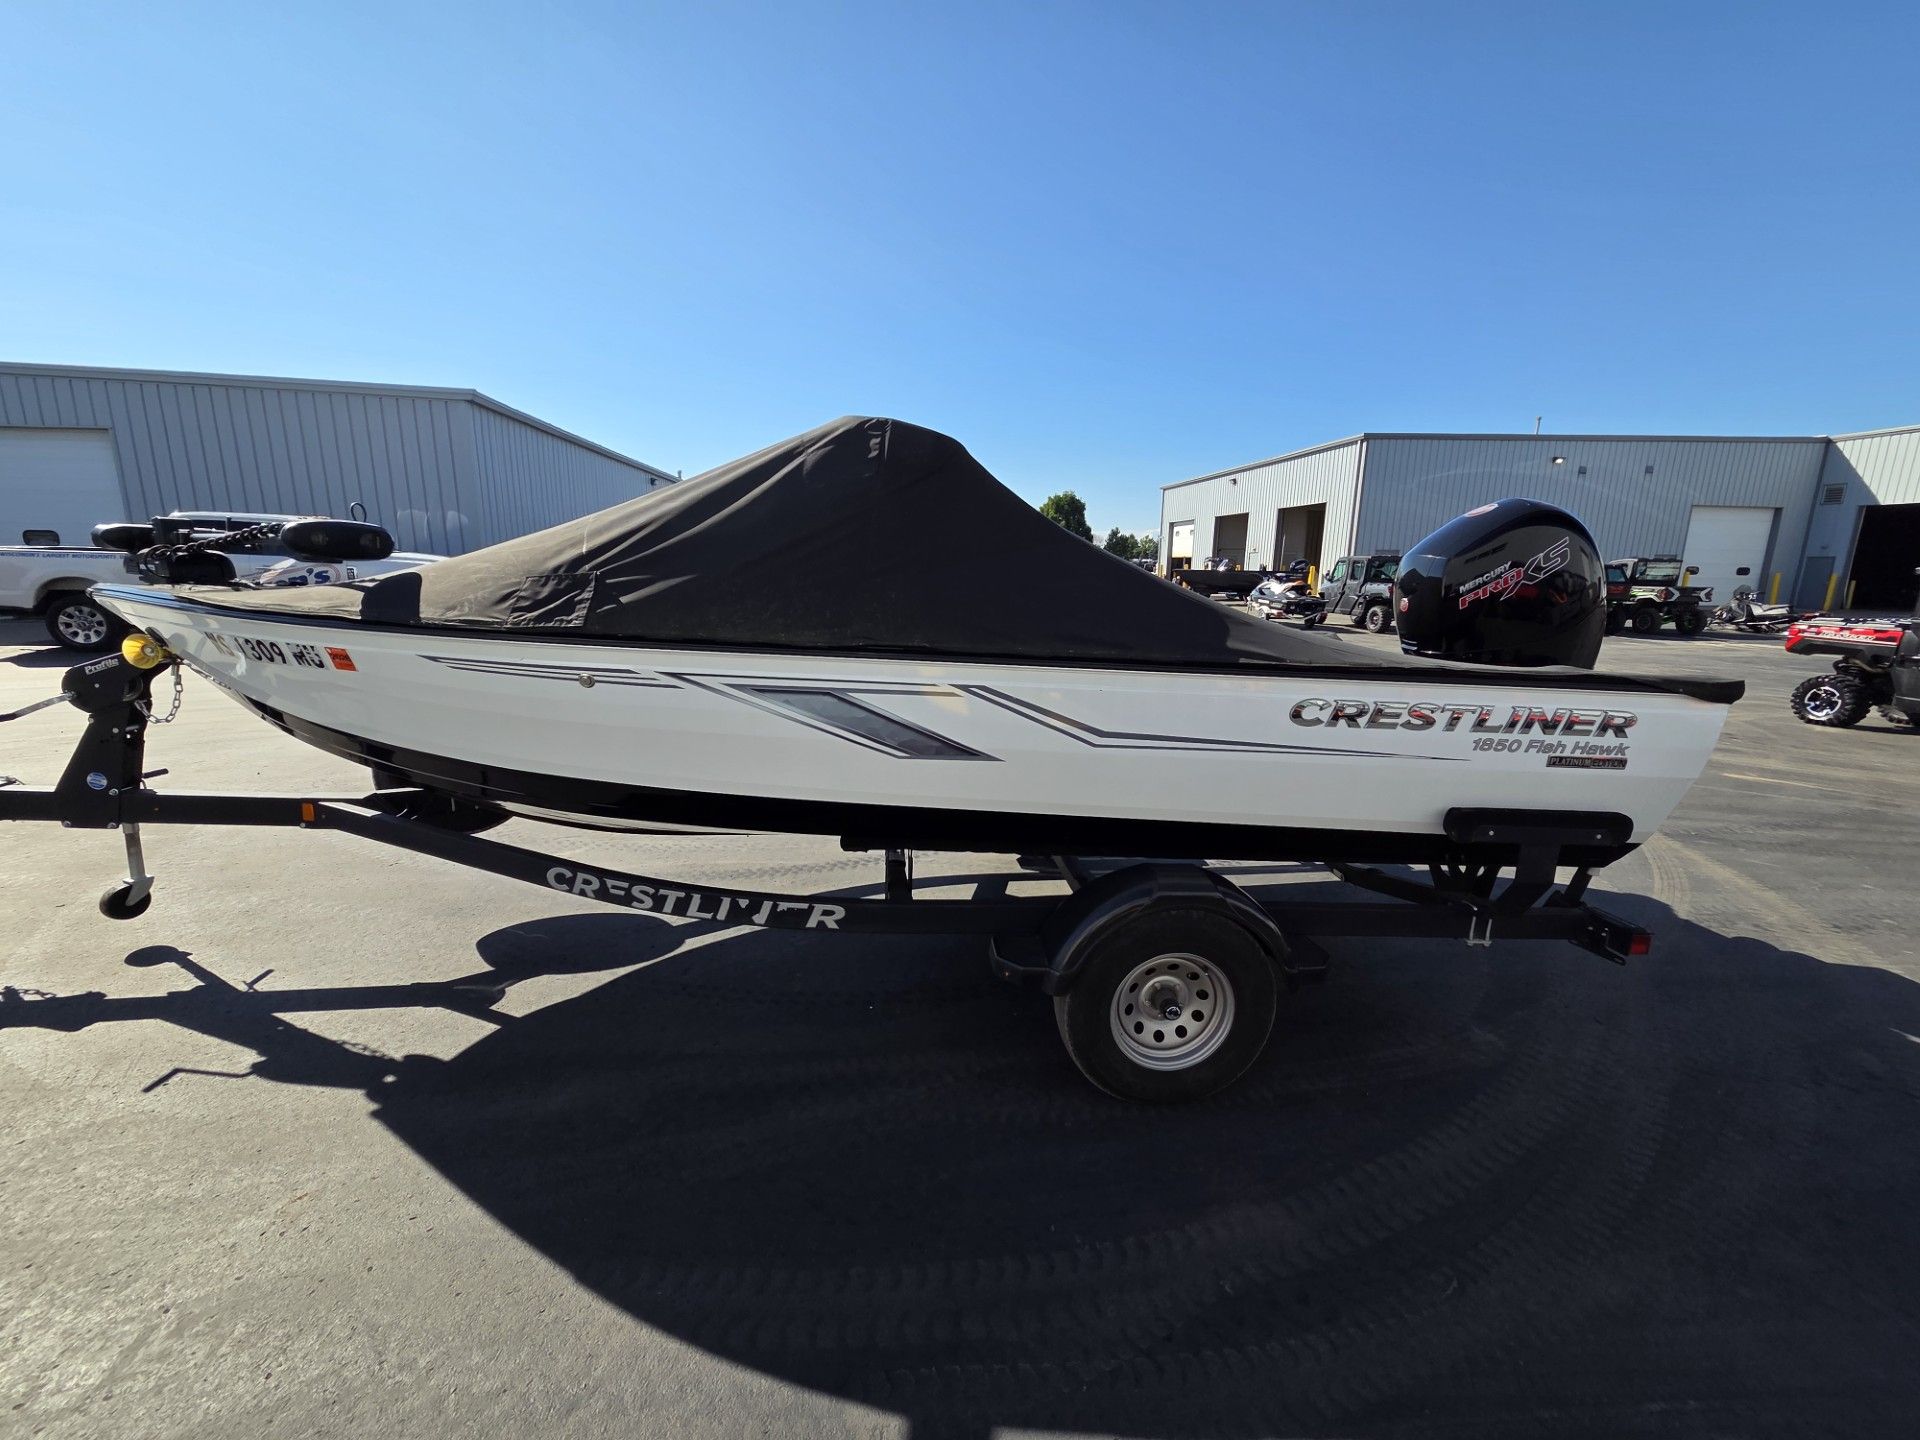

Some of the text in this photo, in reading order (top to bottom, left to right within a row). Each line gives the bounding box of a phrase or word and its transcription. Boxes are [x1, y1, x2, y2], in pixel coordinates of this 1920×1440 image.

[1460, 561, 1511, 593] MERCURY
[84, 658, 119, 675] Profile
[1289, 697, 1639, 739] CRESTLINER
[1472, 738, 1631, 756] 1850 Fish Hawk
[1550, 757, 1591, 767] PLATINUM
[546, 866, 846, 929] CRESTLIR
